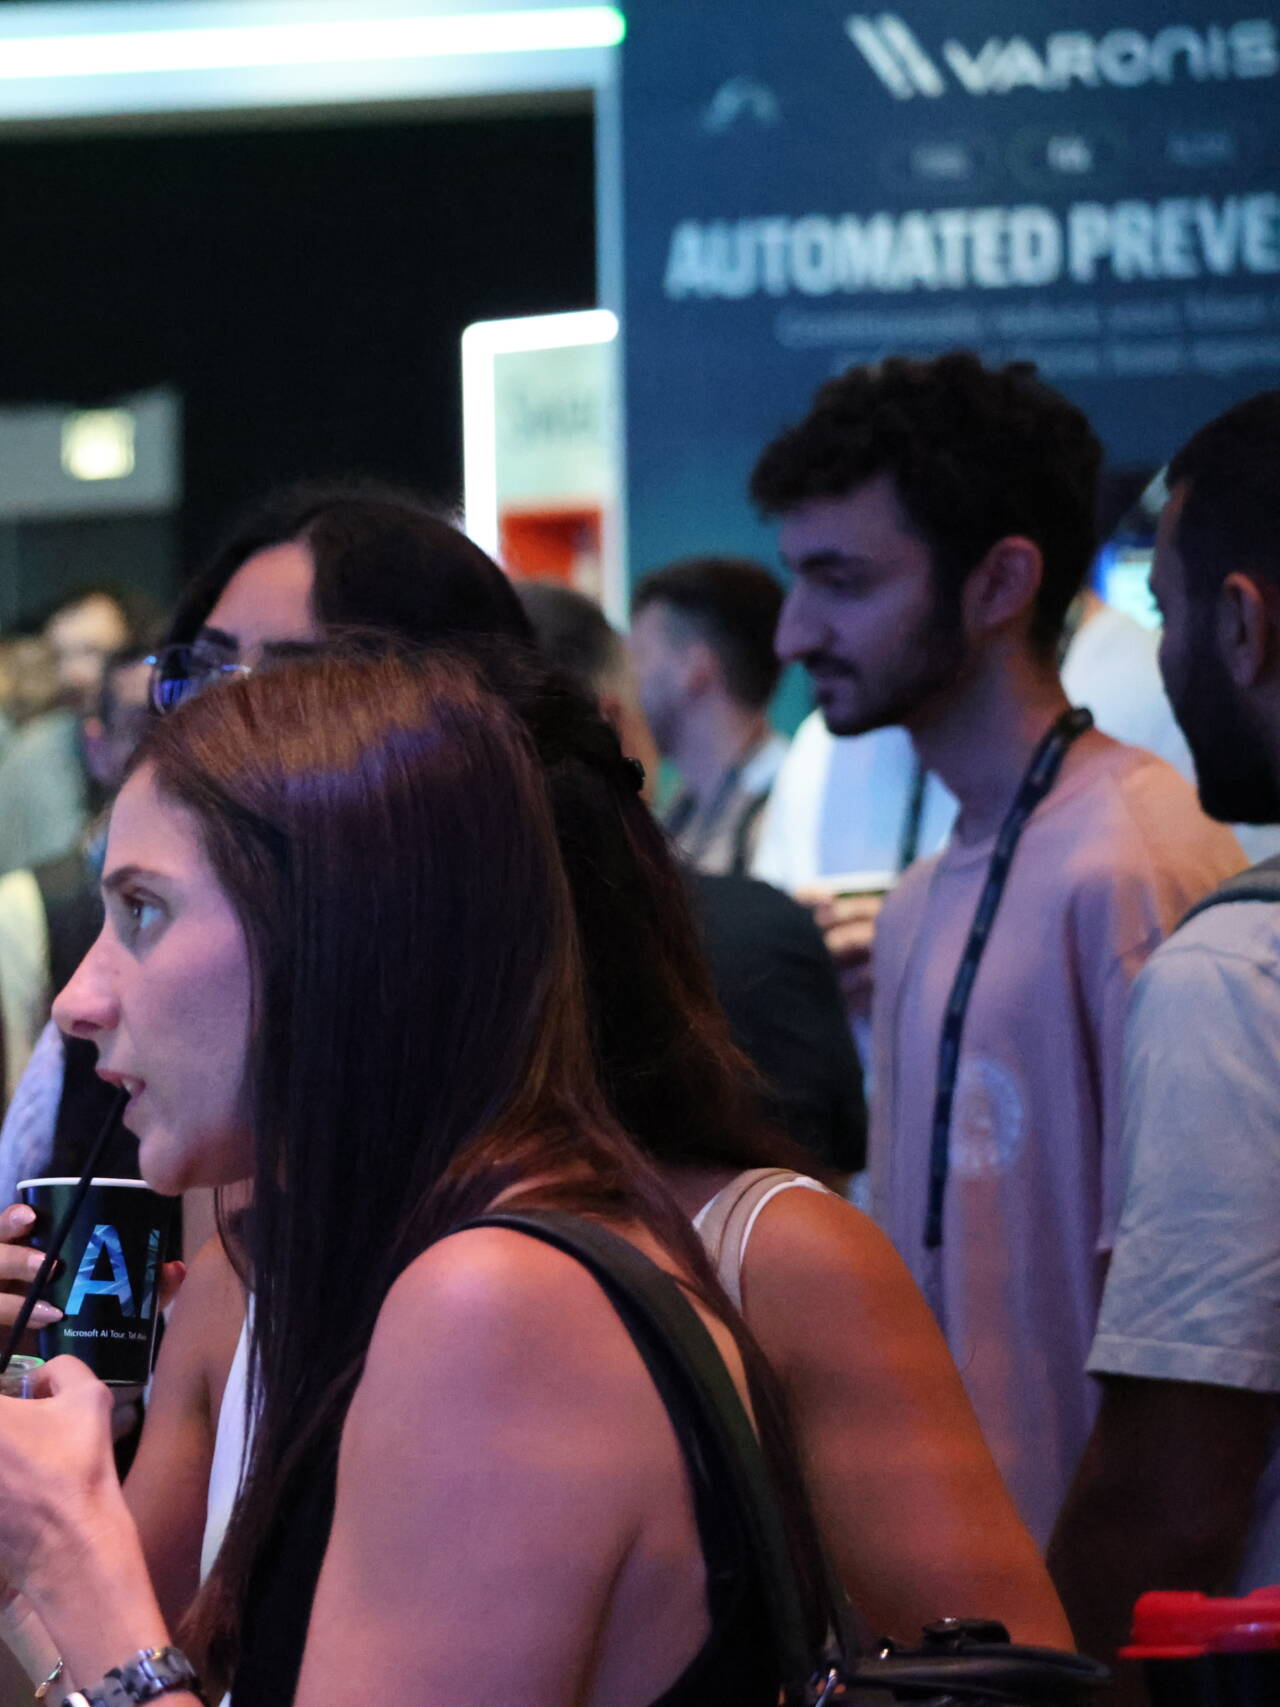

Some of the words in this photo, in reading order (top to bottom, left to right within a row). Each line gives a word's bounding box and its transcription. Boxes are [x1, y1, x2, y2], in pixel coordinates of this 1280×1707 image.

[943, 19, 1278, 94] VARONIS
[665, 205, 1062, 299] AUTOMATED
[1067, 192, 1280, 284] PREVE
[64, 1224, 161, 1320] AI
[63, 1328, 98, 1337] Microsoft
[100, 1329, 108, 1338] AI
